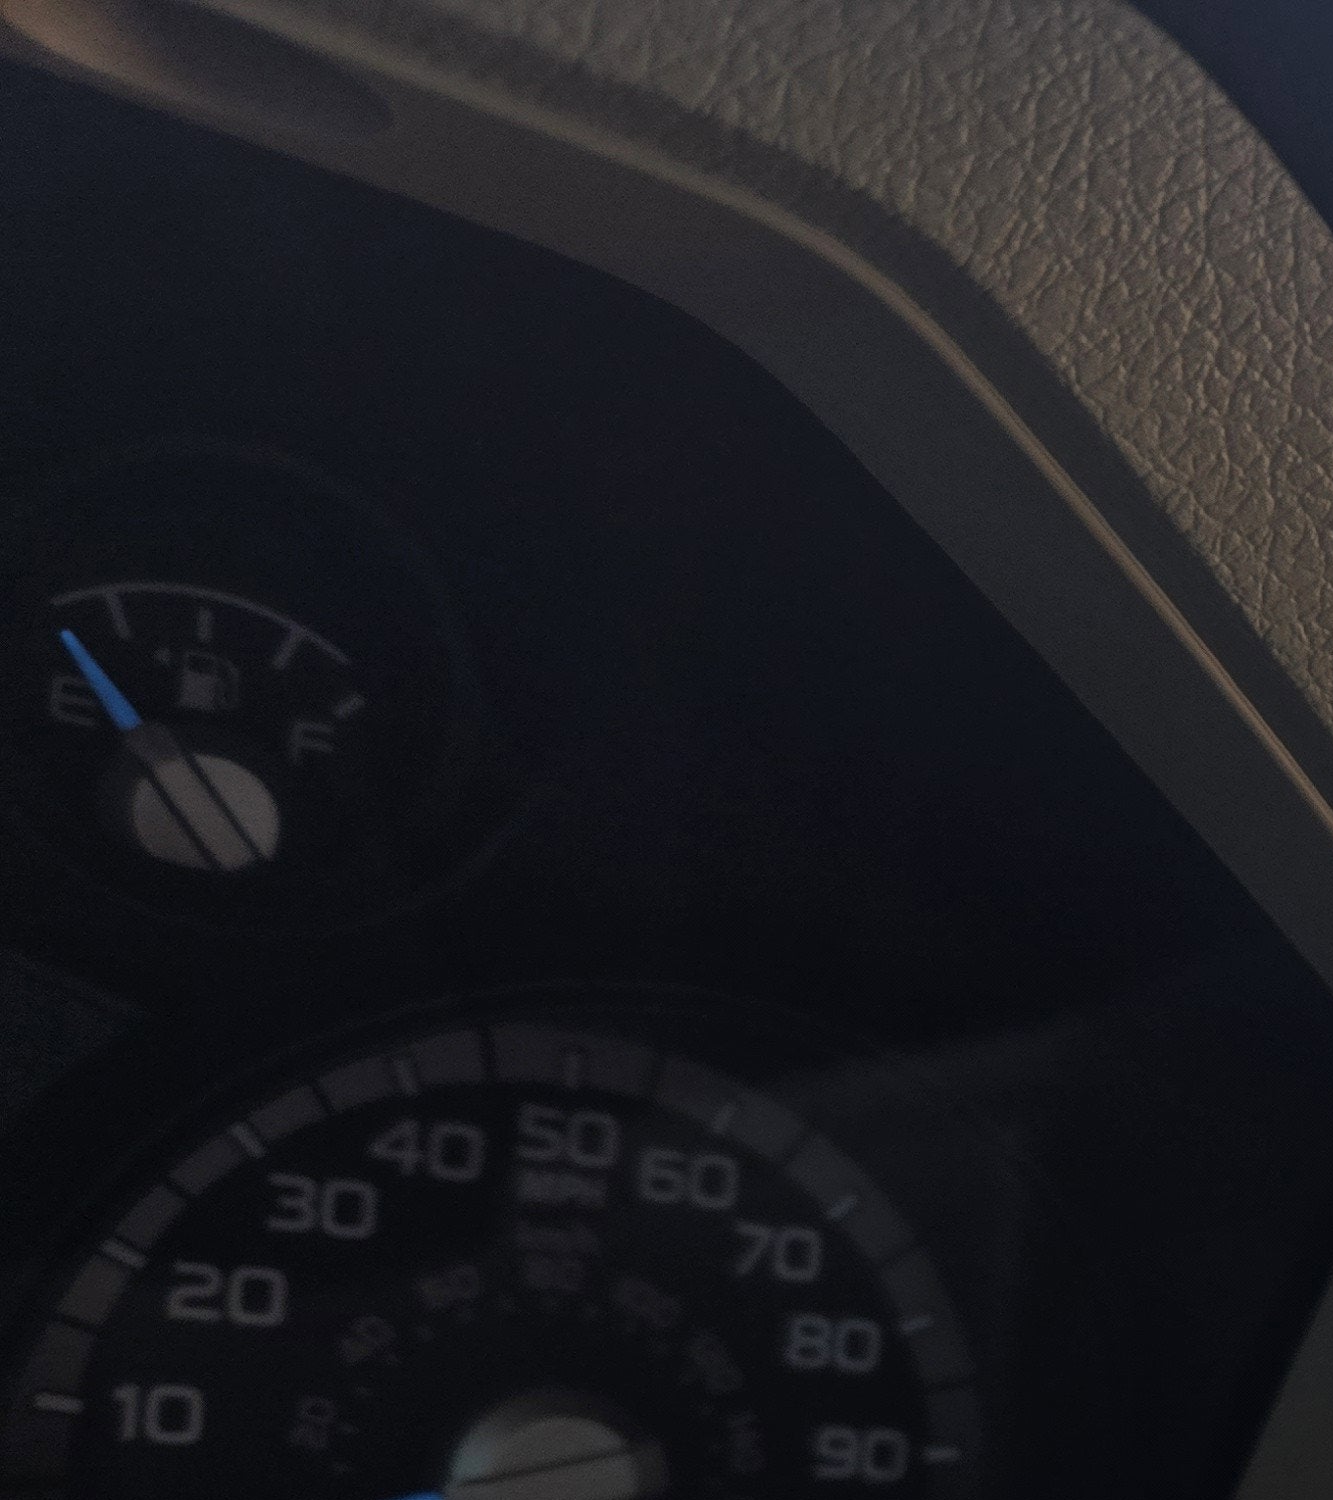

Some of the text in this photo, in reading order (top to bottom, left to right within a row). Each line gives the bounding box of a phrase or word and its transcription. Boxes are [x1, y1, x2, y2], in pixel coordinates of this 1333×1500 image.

[50, 673, 101, 728] E
[286, 718, 336, 767] F
[366, 1118, 487, 1183] 40
[512, 1102, 621, 1169] 50
[265, 1172, 380, 1240] 30
[636, 1144, 741, 1211] 60
[732, 1218, 824, 1282] 70
[164, 1259, 291, 1328] 20
[784, 1313, 883, 1375] 80
[110, 1382, 206, 1446] 10
[812, 1425, 909, 1483] 90
